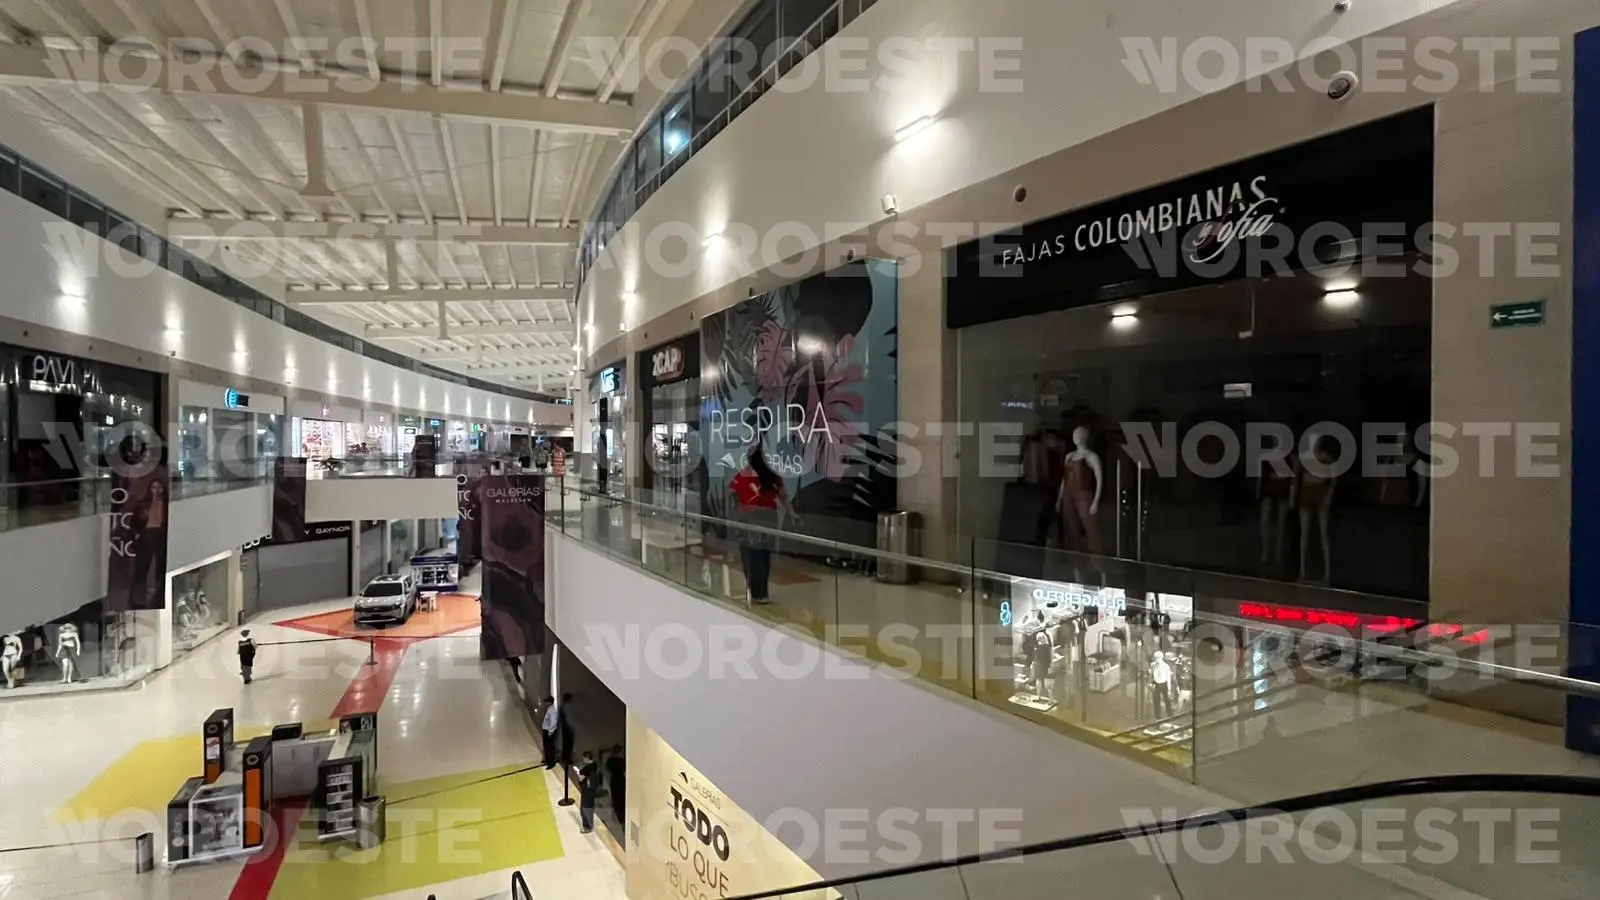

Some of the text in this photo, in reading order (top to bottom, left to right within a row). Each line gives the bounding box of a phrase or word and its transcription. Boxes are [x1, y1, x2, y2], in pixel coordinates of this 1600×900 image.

[1002, 175, 1268, 267] FAJAS COLOMBIANAS
[33, 354, 75, 385] PAVI
[710, 401, 833, 444] RESPIRA
[670, 785, 730, 862] TODO
[670, 825, 729, 898] LO QUE
